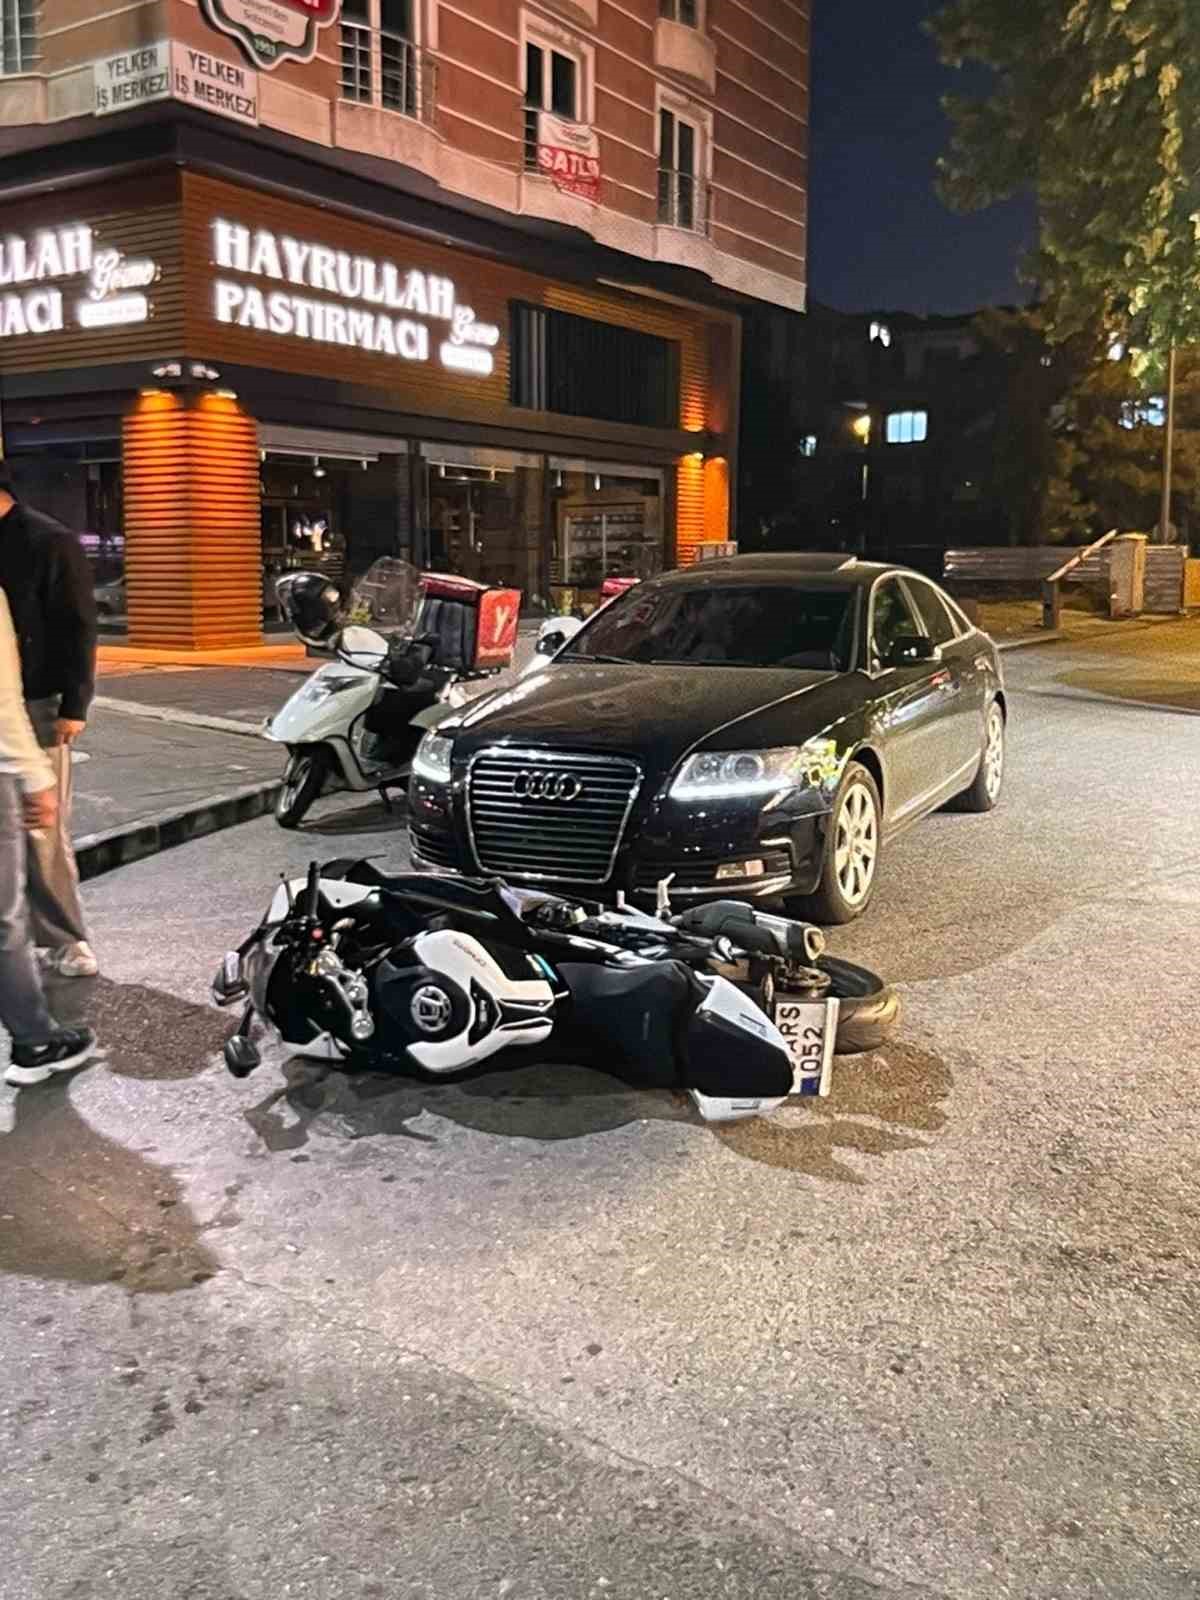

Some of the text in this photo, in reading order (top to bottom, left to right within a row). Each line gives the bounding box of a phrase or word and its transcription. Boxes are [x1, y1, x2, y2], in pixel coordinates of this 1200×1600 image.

[106, 48, 158, 79] YELKEN
[188, 51, 245, 88] YELKEN
[111, 67, 169, 103] MERKEZİ
[194, 79, 257, 119] MERKEZİ
[213, 218, 455, 319] HAYRULLAH
[214, 280, 430, 361] PASTIRMACI
[801, 1027, 824, 1072] 052
